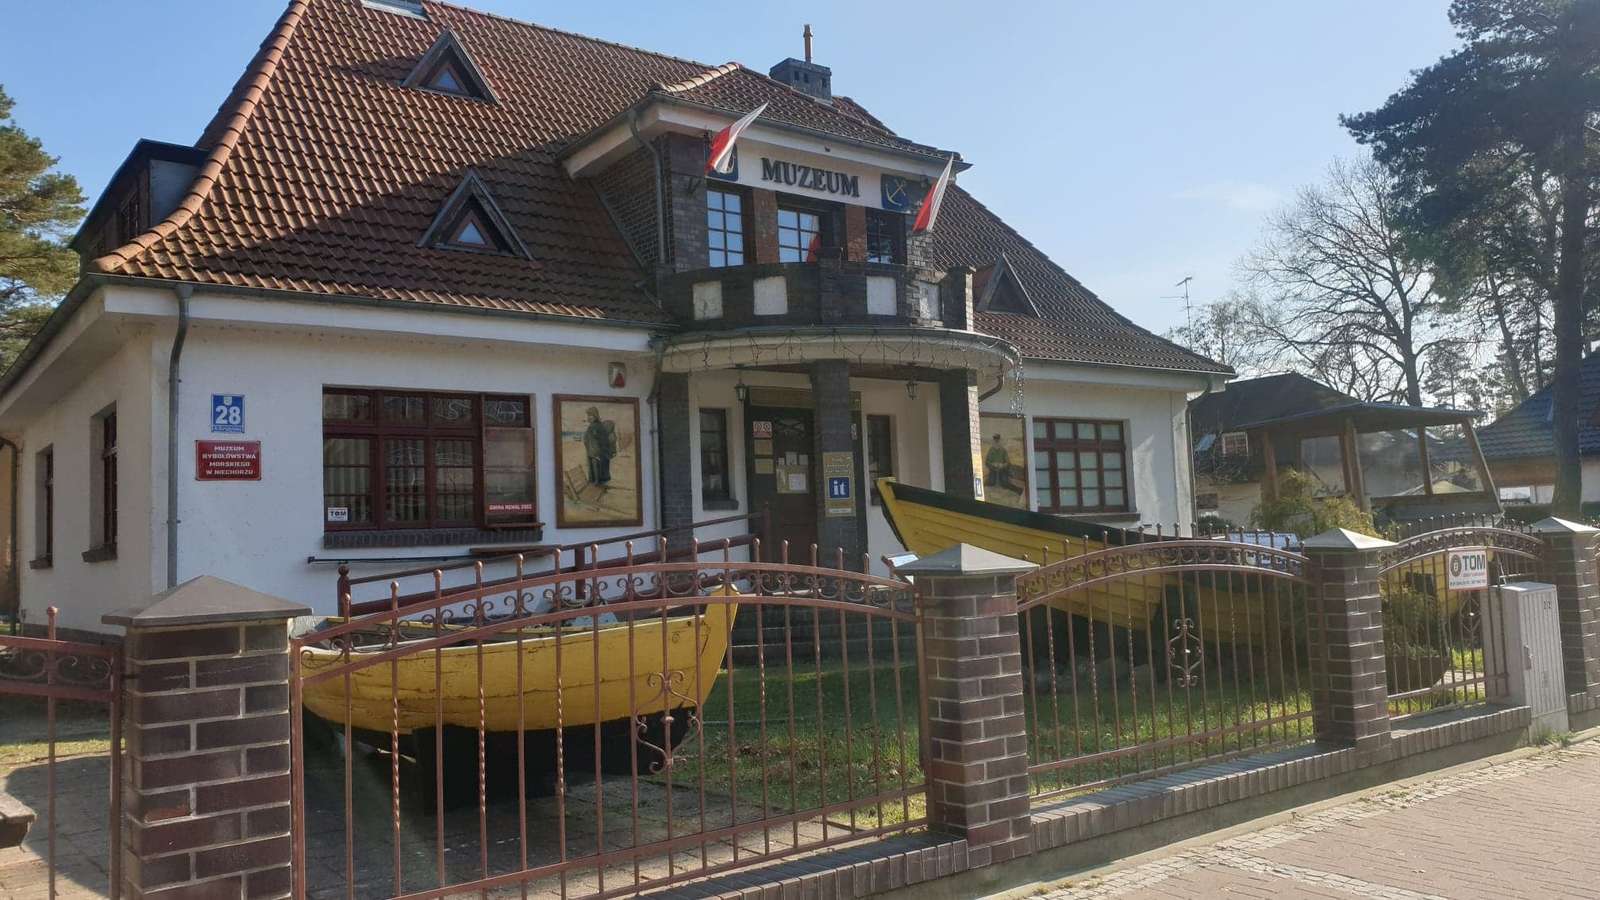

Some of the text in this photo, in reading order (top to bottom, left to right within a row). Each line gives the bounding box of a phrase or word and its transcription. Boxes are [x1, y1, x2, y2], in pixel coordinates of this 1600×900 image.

[761, 157, 860, 198] MUZEUM
[215, 405, 241, 425] 28
[833, 479, 847, 496] it
[1462, 554, 1486, 571] TOM
